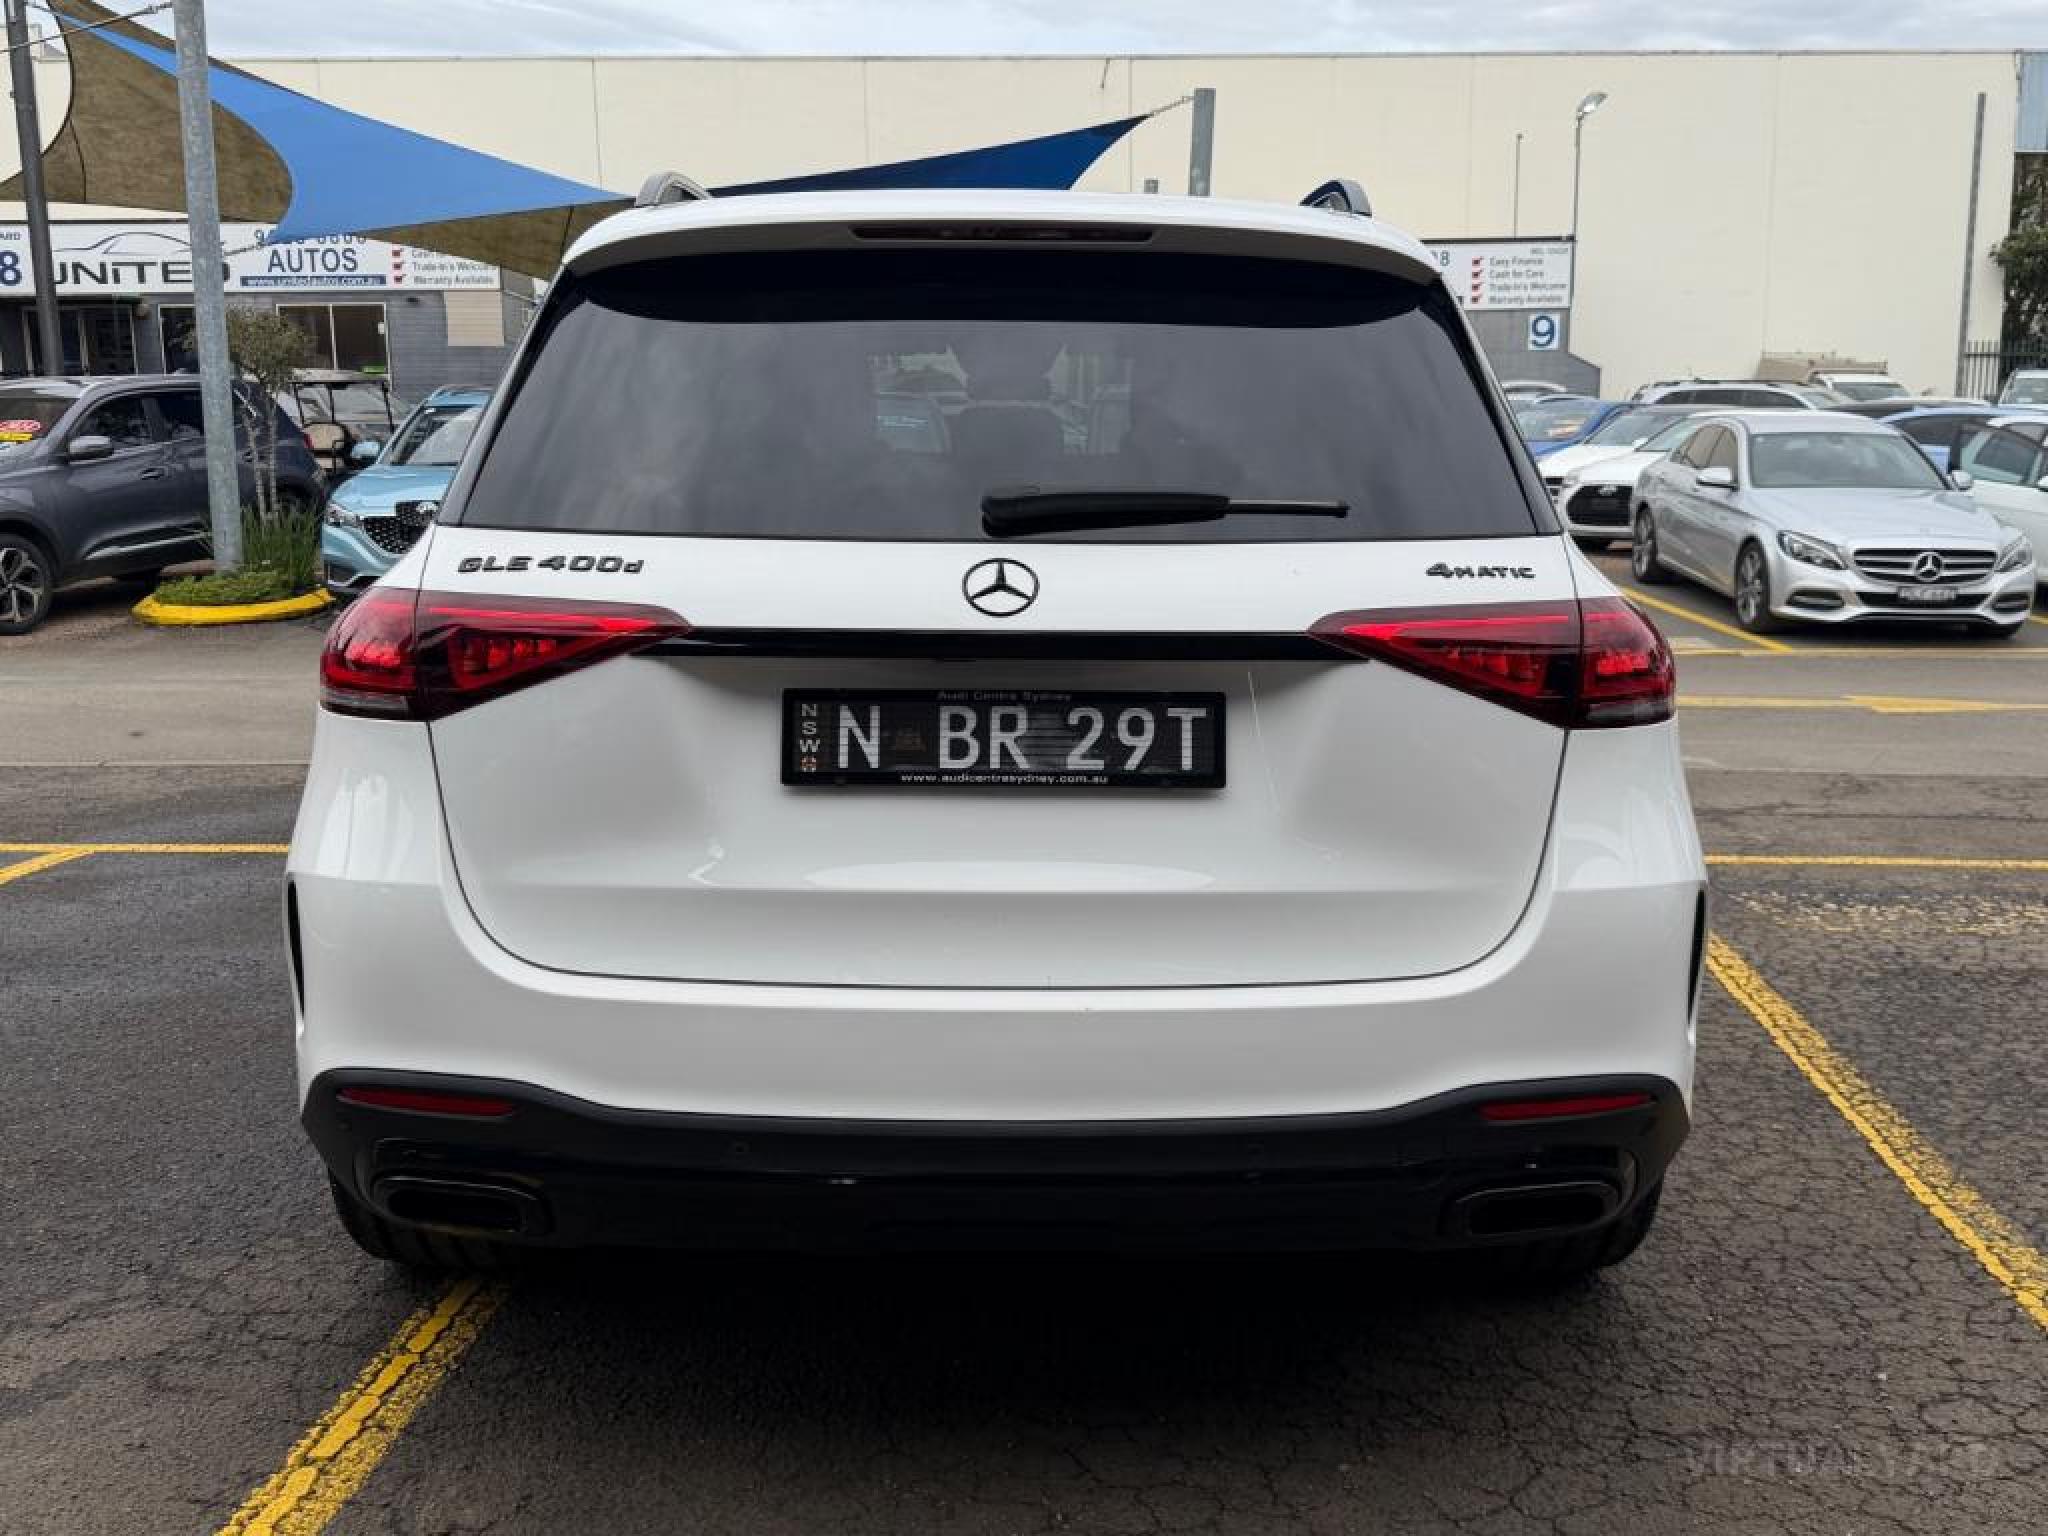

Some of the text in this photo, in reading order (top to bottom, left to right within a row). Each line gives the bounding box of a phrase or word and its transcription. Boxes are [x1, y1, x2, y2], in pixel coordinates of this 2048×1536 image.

[53, 261, 230, 284] UNITE
[268, 248, 359, 273] AUTOS
[1532, 315, 1556, 347] 9
[457, 556, 645, 574] GLE 400d
[1426, 562, 1536, 580] 4MATIC
[838, 705, 1207, 770] N BR 29T
